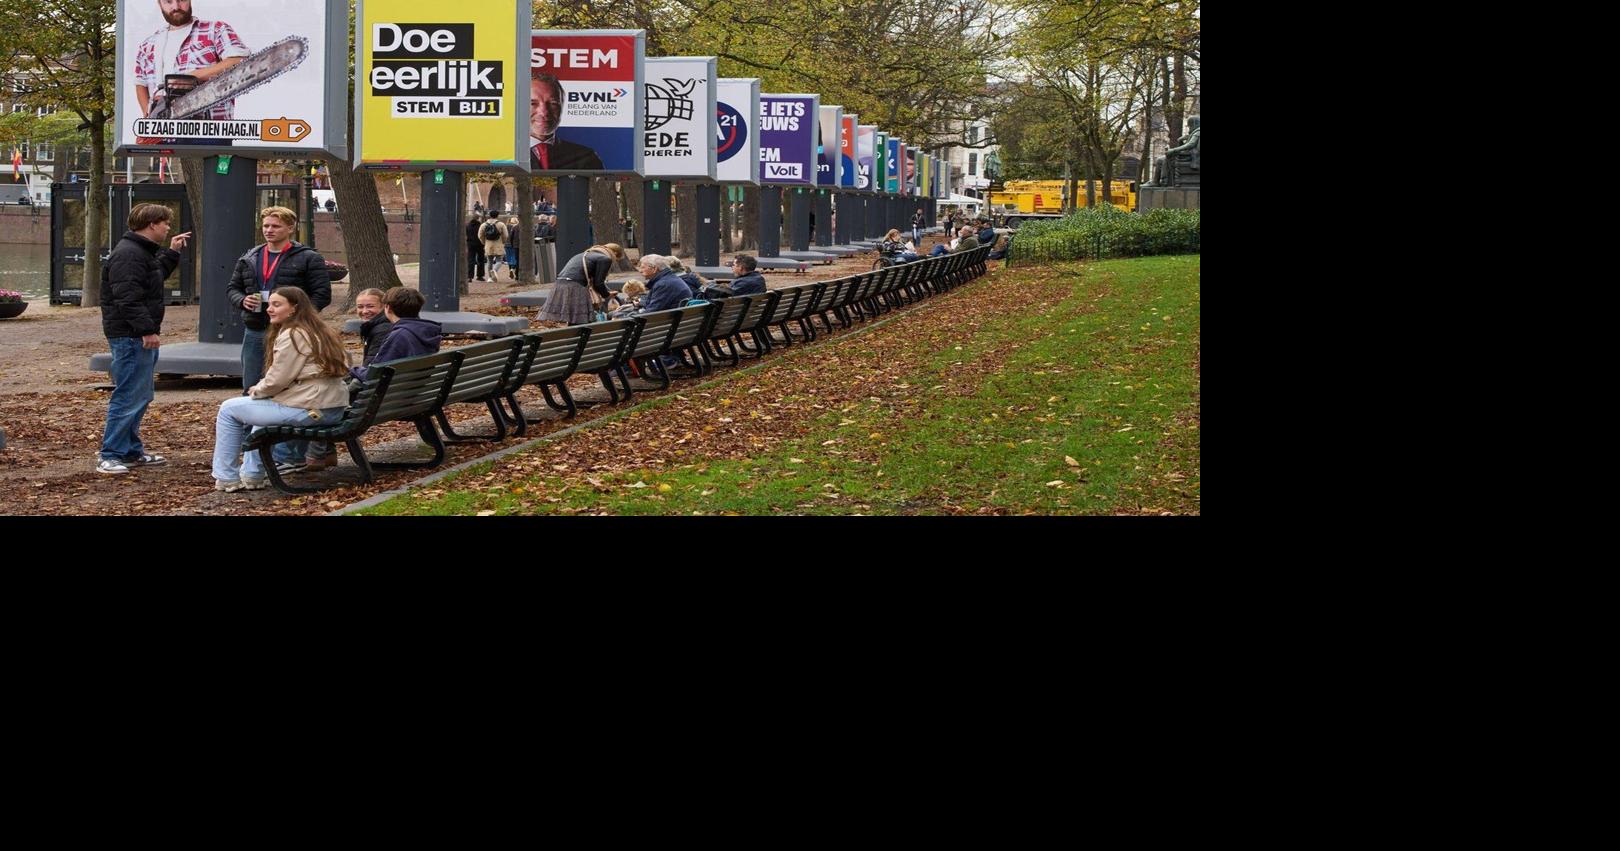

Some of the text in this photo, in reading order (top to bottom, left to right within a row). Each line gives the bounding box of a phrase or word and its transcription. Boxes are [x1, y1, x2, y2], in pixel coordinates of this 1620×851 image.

[372, 23, 456, 53] Doe
[531, 47, 618, 69] STEM
[371, 61, 504, 97] eerlijk.
[568, 92, 617, 103] BVNL
[396, 101, 497, 114] STEM BIJ1
[771, 102, 805, 116] IETS
[138, 121, 260, 137] DE ZAAG DOOR DEN HAAG.NL
[644, 149, 692, 157] DIEREN
[770, 165, 798, 176] Volt
